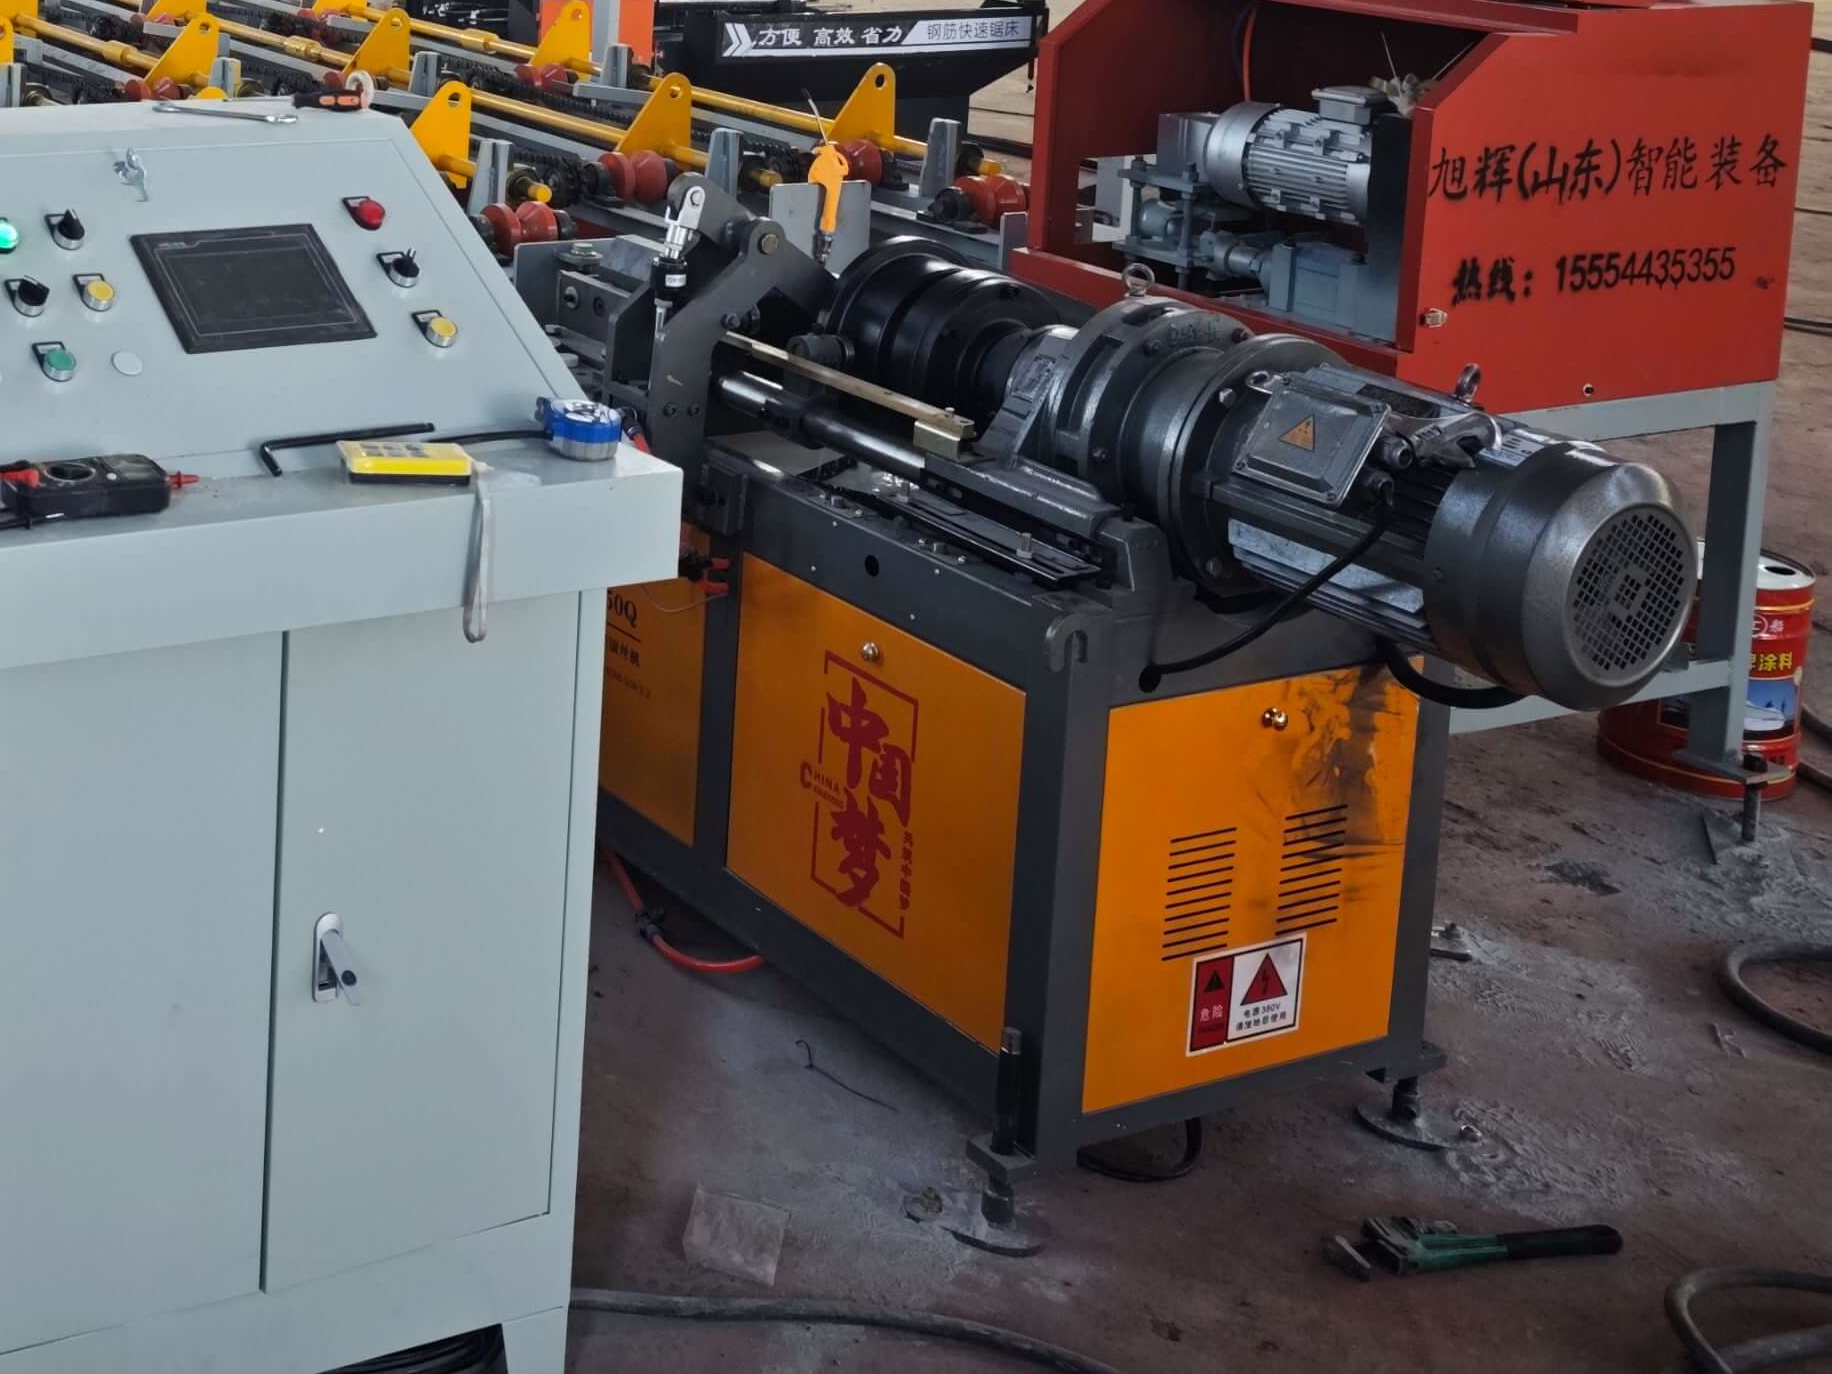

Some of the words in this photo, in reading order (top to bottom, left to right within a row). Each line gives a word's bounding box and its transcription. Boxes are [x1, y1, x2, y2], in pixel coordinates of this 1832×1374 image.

[758, 28, 802, 46] 方便
[813, 27, 855, 46] 高效
[861, 26, 903, 44] 省力
[1556, 246, 1736, 293] 15554435355
